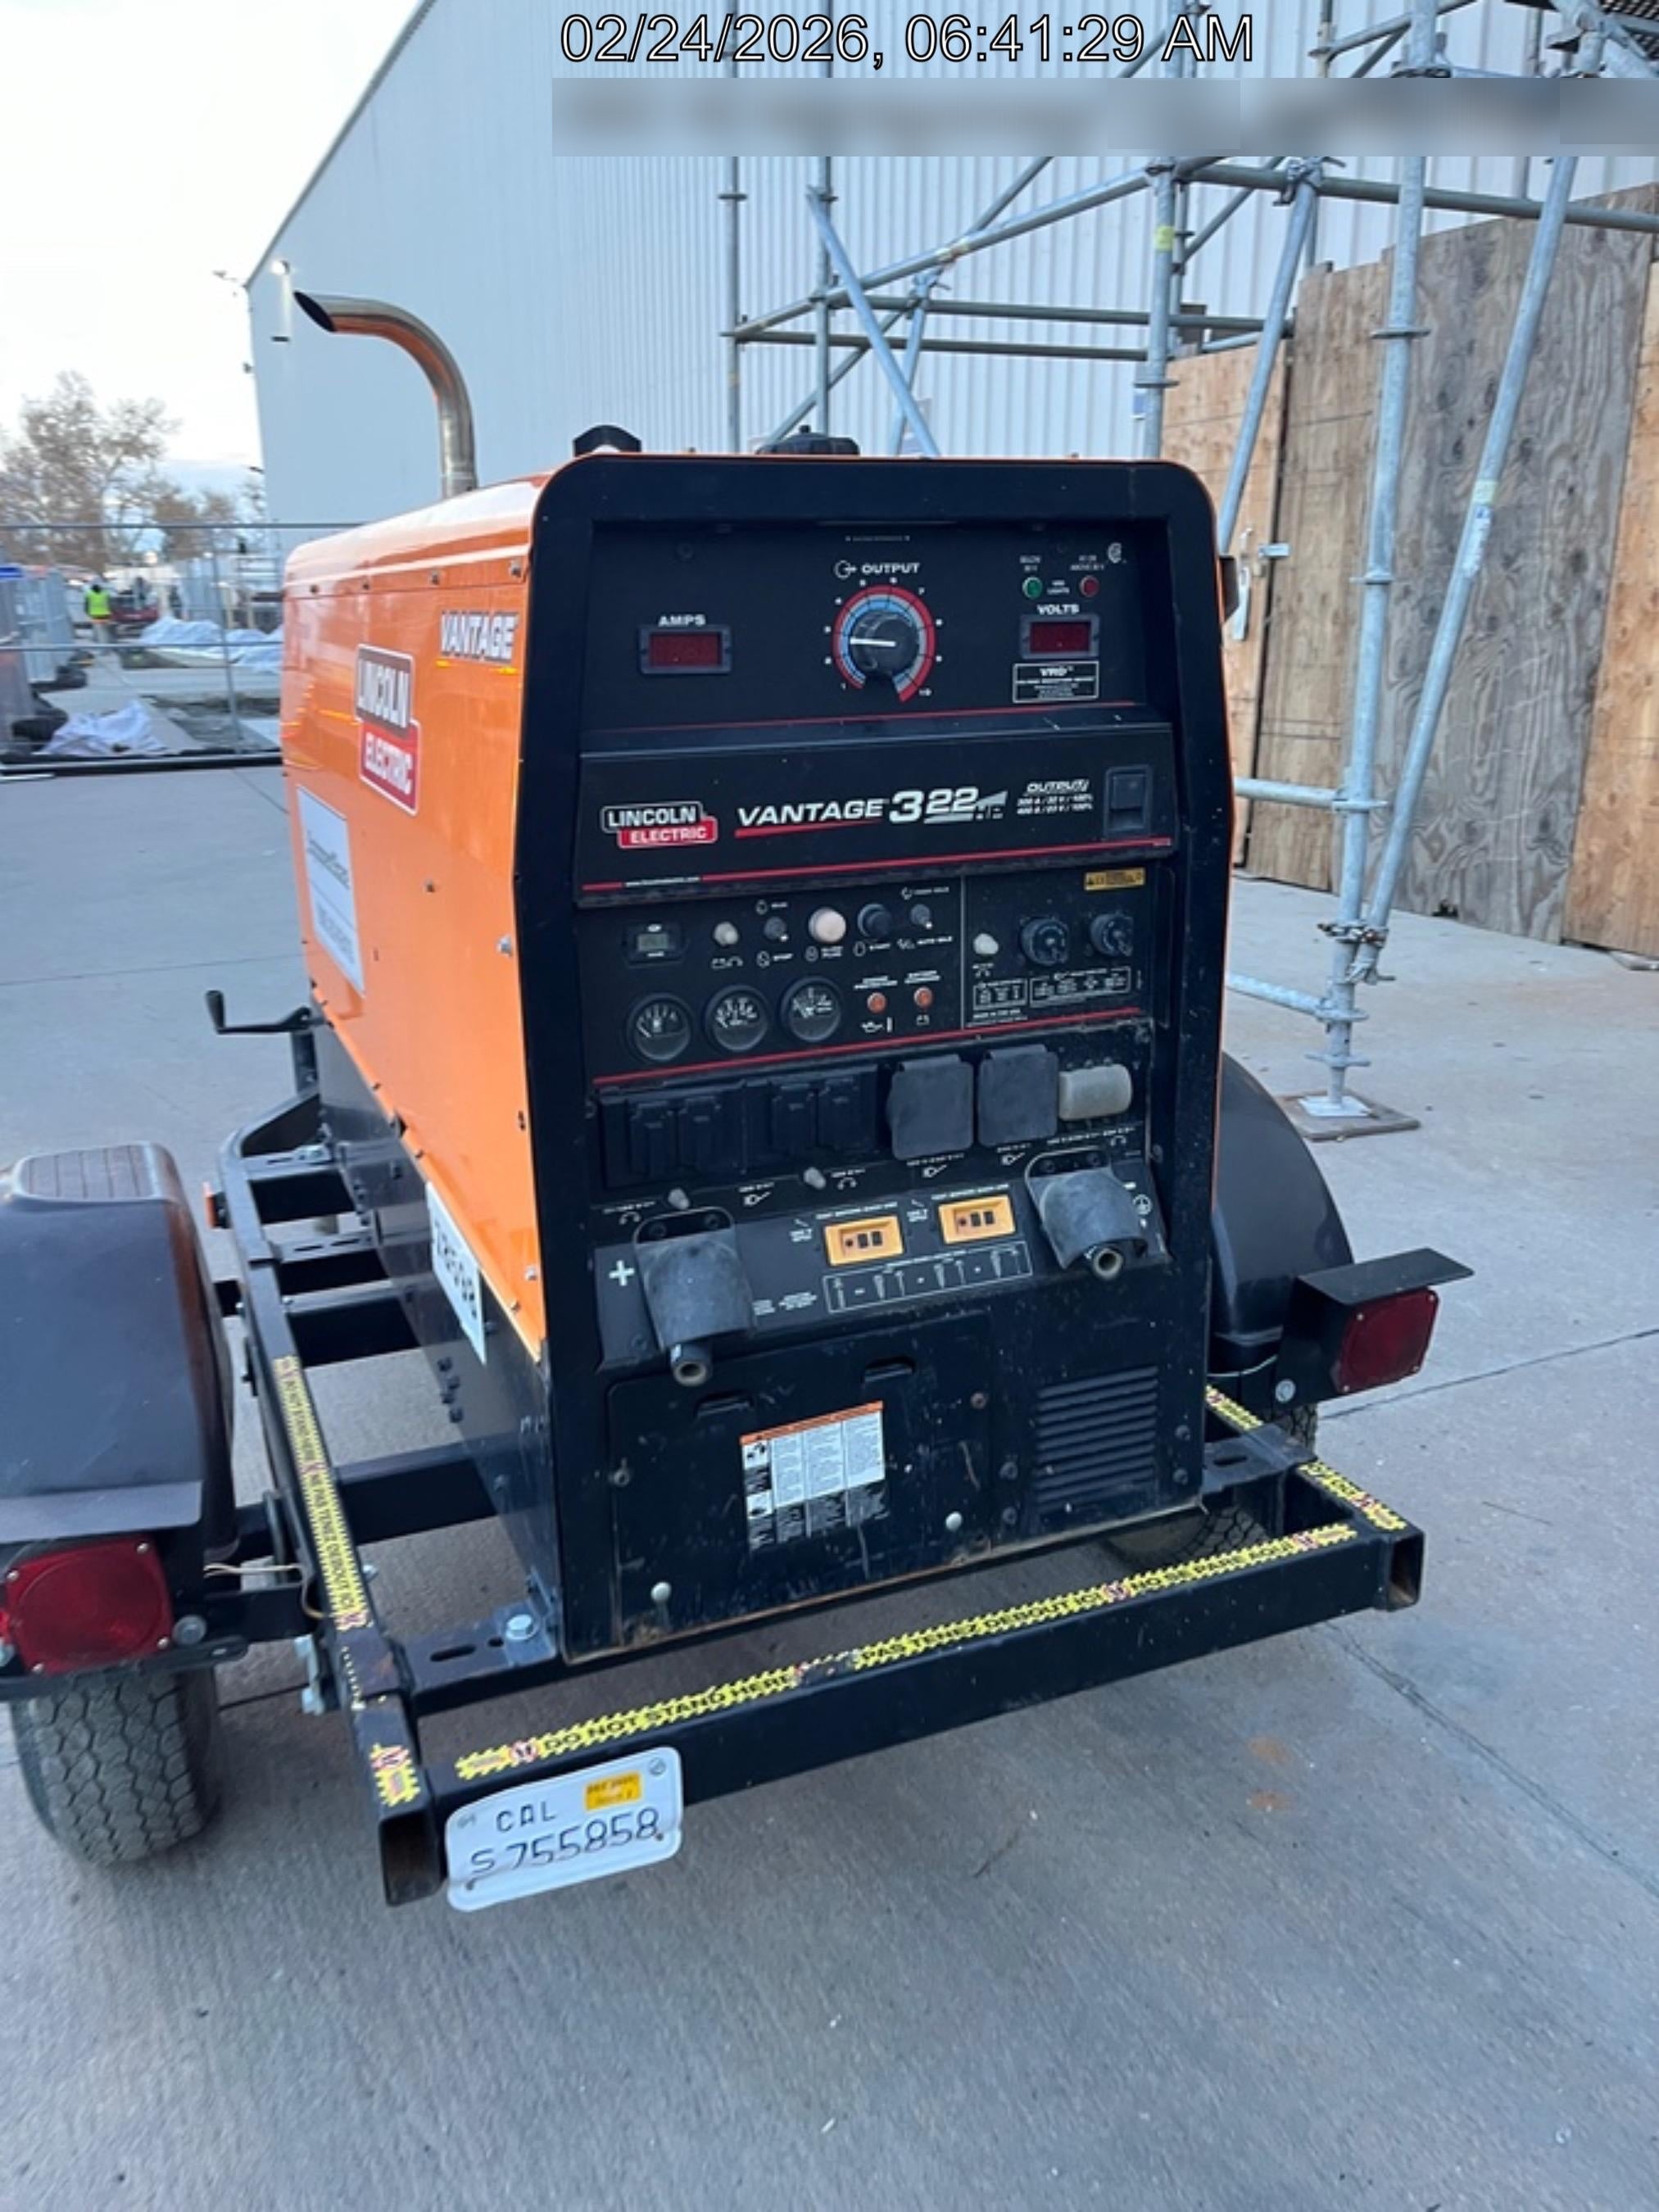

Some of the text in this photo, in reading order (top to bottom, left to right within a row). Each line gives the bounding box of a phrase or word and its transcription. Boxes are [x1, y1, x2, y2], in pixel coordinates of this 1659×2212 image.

[862, 562, 921, 573] OUTPUT
[657, 614, 706, 628] AMPS
[1036, 603, 1081, 615] VOLTS
[440, 614, 518, 660] VANTAGE
[356, 658, 410, 728] LINCOLN
[608, 805, 696, 827] LINCOLN
[737, 799, 884, 827] VANTAGE
[889, 786, 979, 823] 322
[629, 826, 708, 845] ELECTRIC
[543, 1730, 581, 1749] DO
[587, 1715, 639, 1738] NOT
[646, 1691, 726, 1723] STAND
[496, 1801, 557, 1833] CAL
